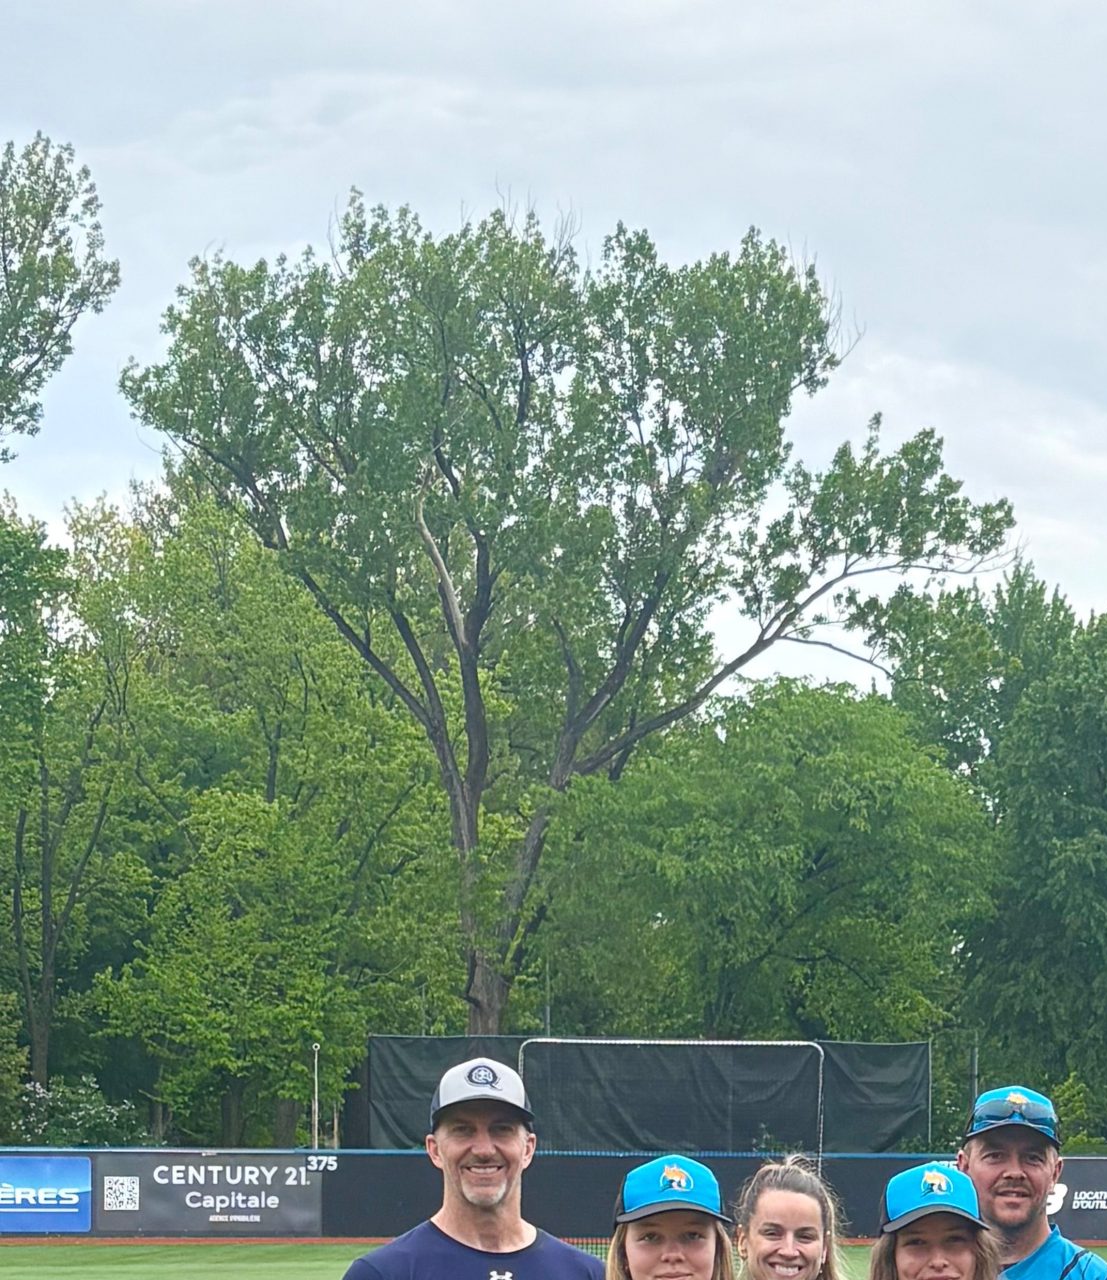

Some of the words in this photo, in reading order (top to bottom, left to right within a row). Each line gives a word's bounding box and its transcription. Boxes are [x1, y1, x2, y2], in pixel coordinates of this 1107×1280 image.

[307, 1156, 338, 1171] 375
[153, 1165, 278, 1185] CENTURY
[185, 1191, 280, 1213] Capitale
